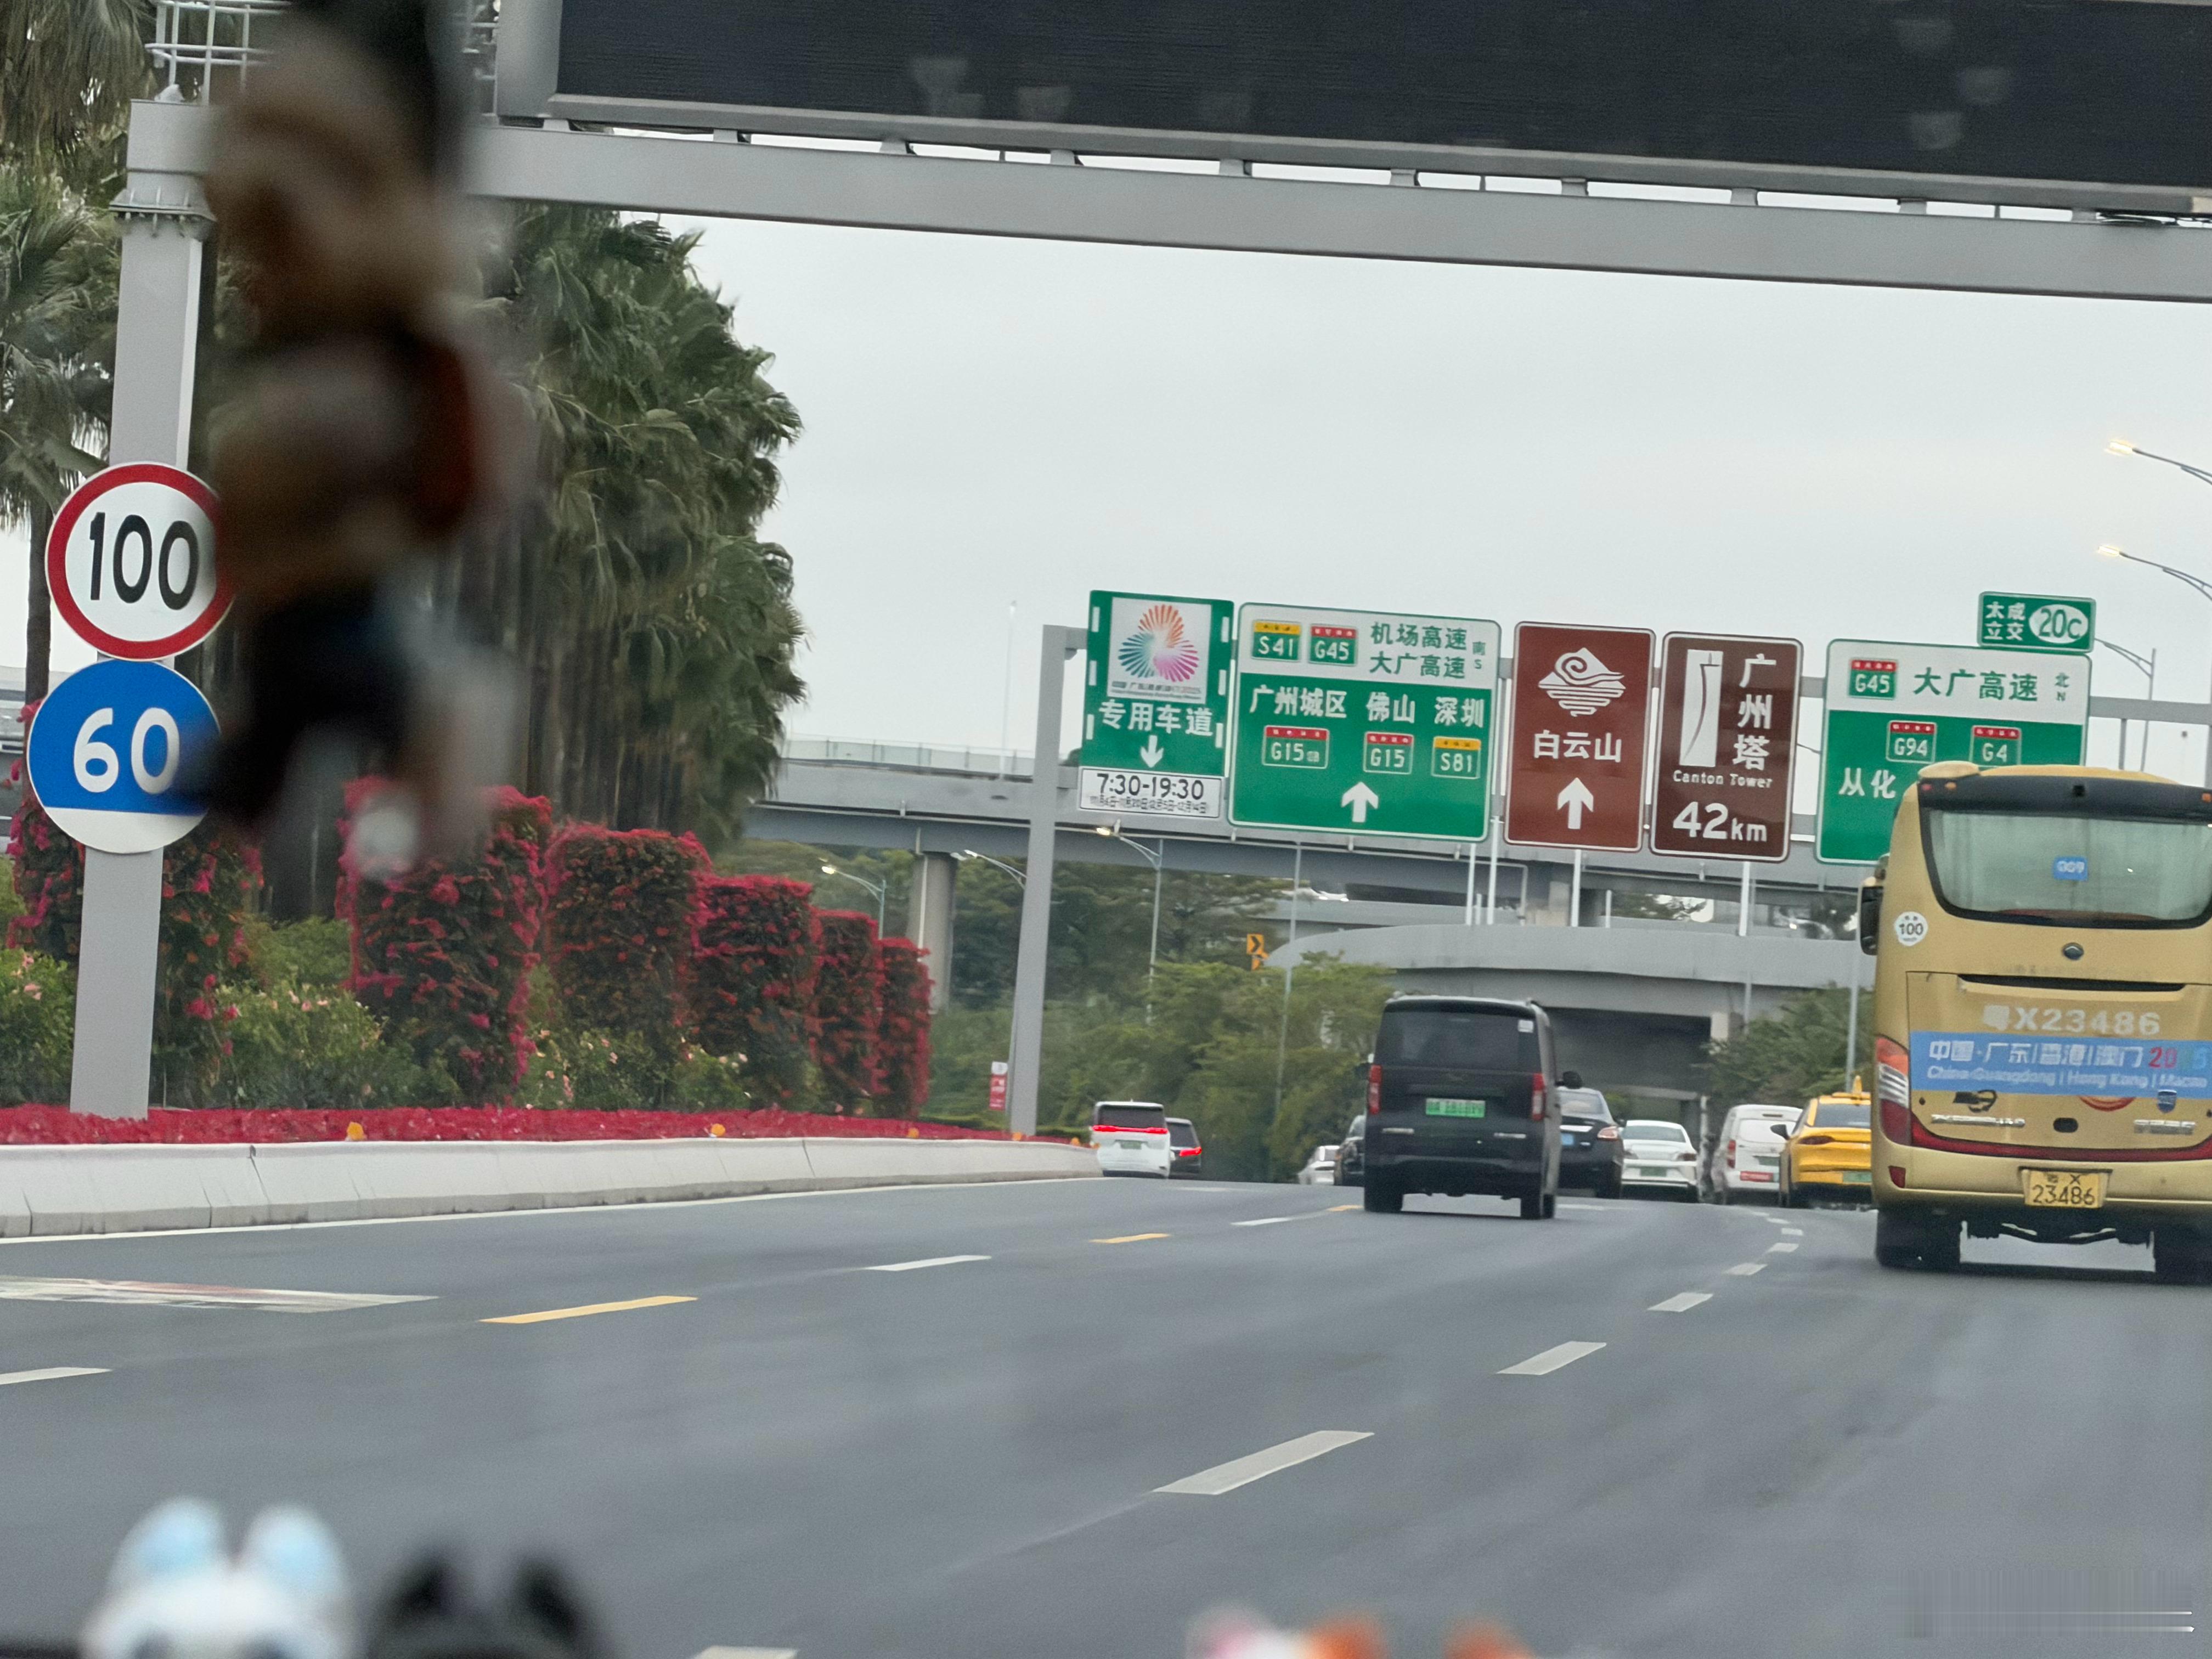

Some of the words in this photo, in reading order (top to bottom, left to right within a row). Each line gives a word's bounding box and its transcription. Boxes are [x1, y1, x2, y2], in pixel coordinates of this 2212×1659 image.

[89, 512, 199, 610] 100
[1369, 621, 1468, 650] 机场高速
[1983, 620, 2024, 641] 立交
[1258, 635, 1294, 657] S41
[1314, 640, 1350, 661] G45
[1369, 651, 1466, 679] 大广高速
[1855, 673, 1890, 693] G45
[1912, 667, 2039, 702] 大广高速
[1098, 698, 1213, 737] 专用车道
[1249, 684, 1347, 719] 广州城区
[1365, 691, 1417, 724] 佛山
[1434, 695, 1485, 729] 深圳
[1732, 653, 1778, 770] 广州塔
[73, 707, 180, 794] 60
[1370, 748, 1405, 768] G15
[1533, 730, 1623, 763] 白云山
[1894, 737, 1928, 757] G94
[1982, 742, 2008, 763] G4
[1440, 753, 1472, 773] S81
[1097, 772, 1204, 800] 7:30-19:30
[1673, 769, 1724, 785] Canton
[1730, 773, 1773, 789] Tower
[1838, 766, 1897, 800] 从化
[1673, 800, 1768, 842] 42km
[1899, 923, 1924, 936] 100
[1983, 1004, 2162, 1037] X23486
[2032, 1184, 2096, 1206] 23486
